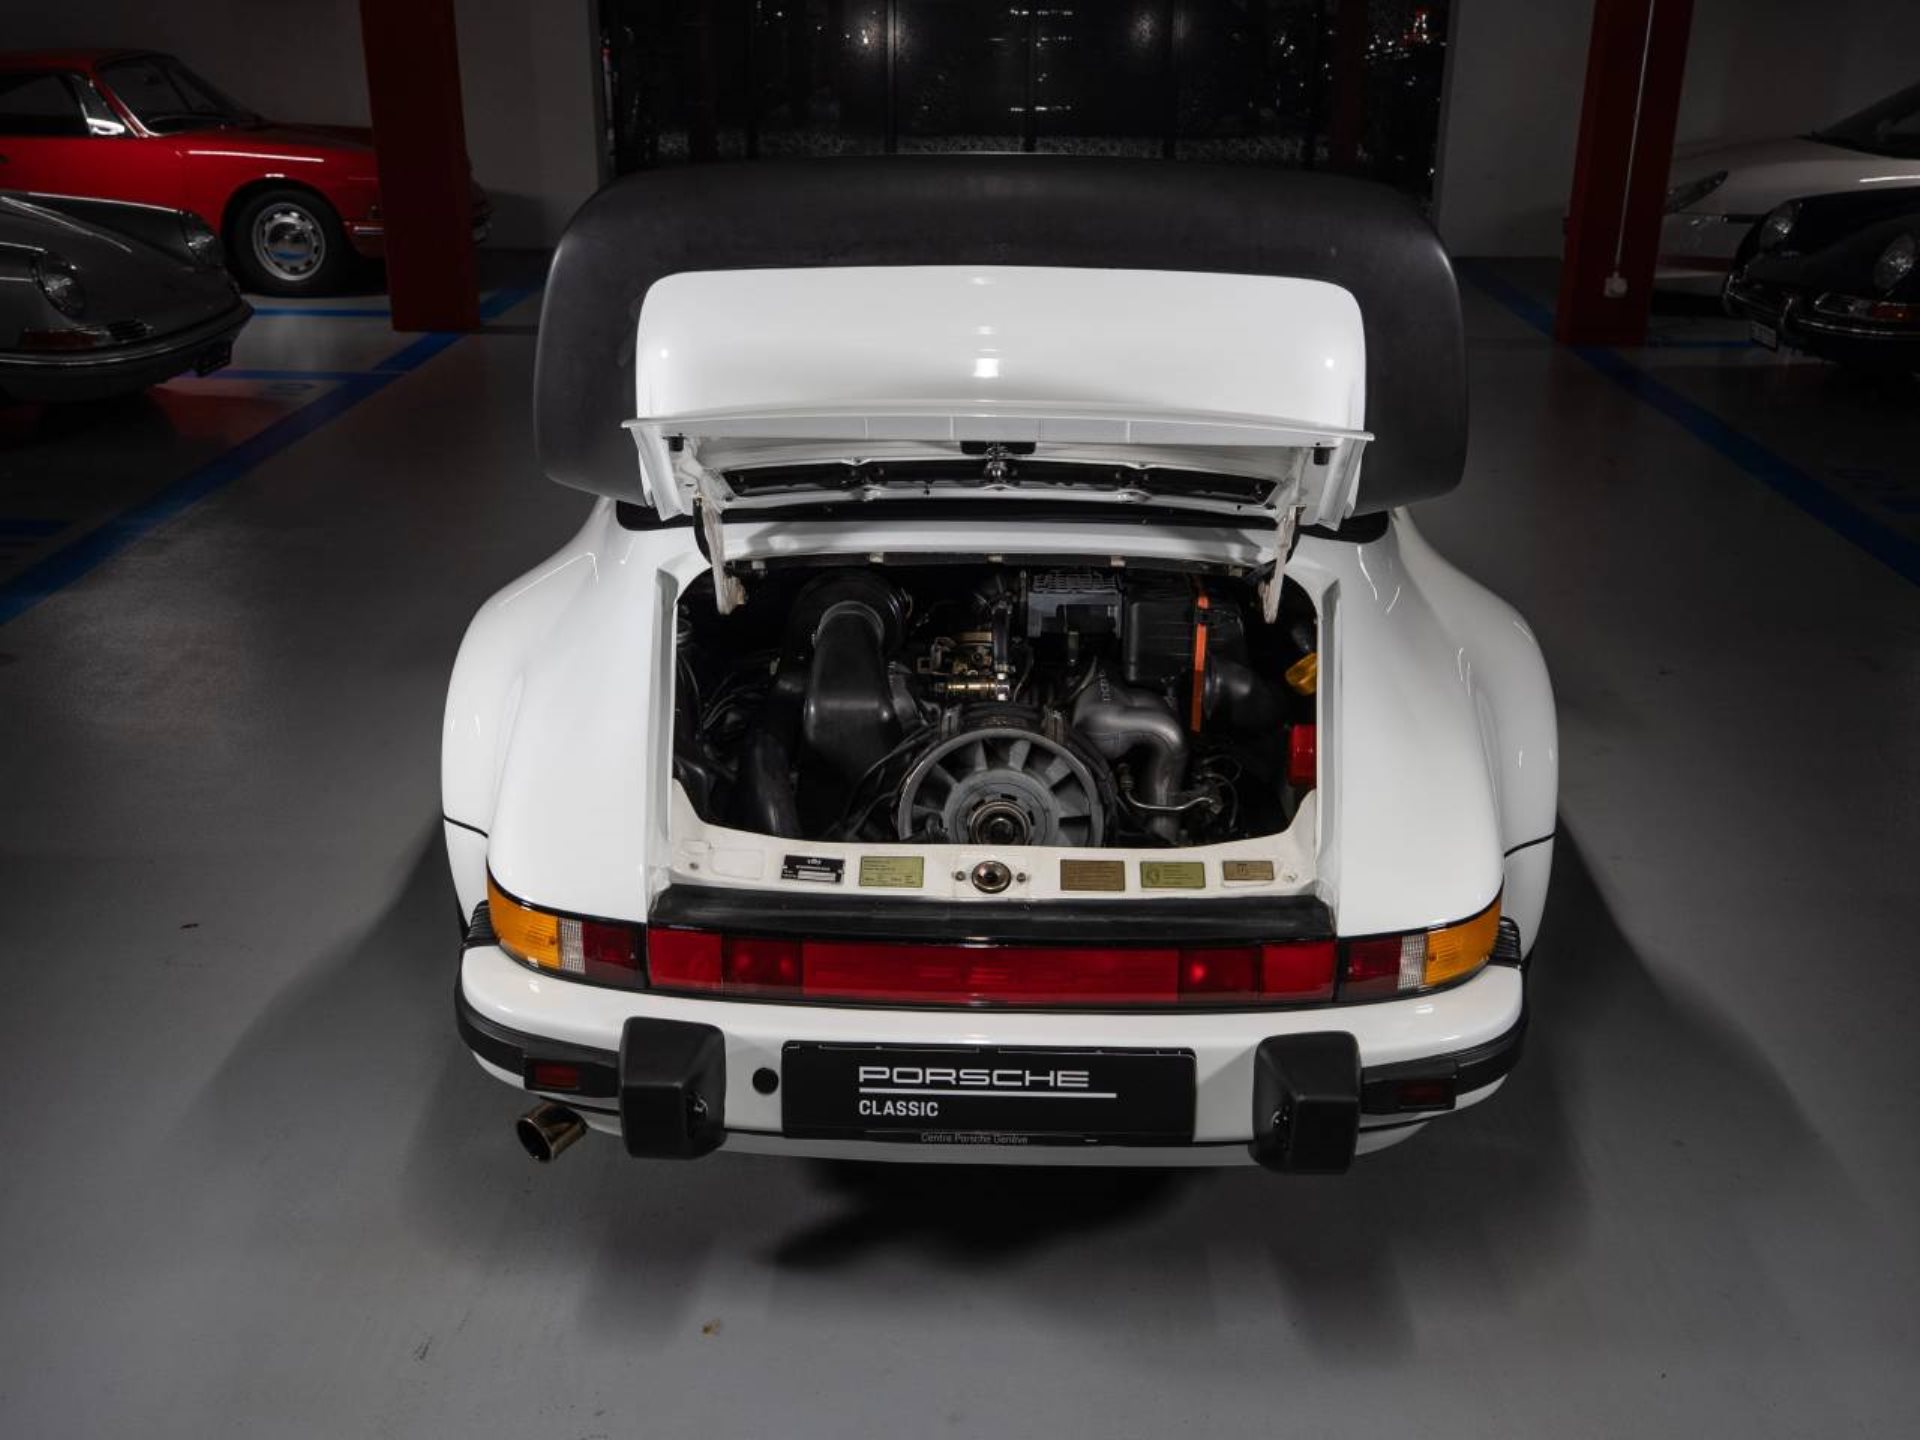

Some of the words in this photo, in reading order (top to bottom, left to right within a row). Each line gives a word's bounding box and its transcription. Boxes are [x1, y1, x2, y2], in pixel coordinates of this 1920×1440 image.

[858, 1066, 1090, 1088] PORSCHE
[858, 1099, 940, 1117] CLASSIC
[921, 1132, 952, 1143] Centre
[954, 1132, 991, 1143] Porsche
